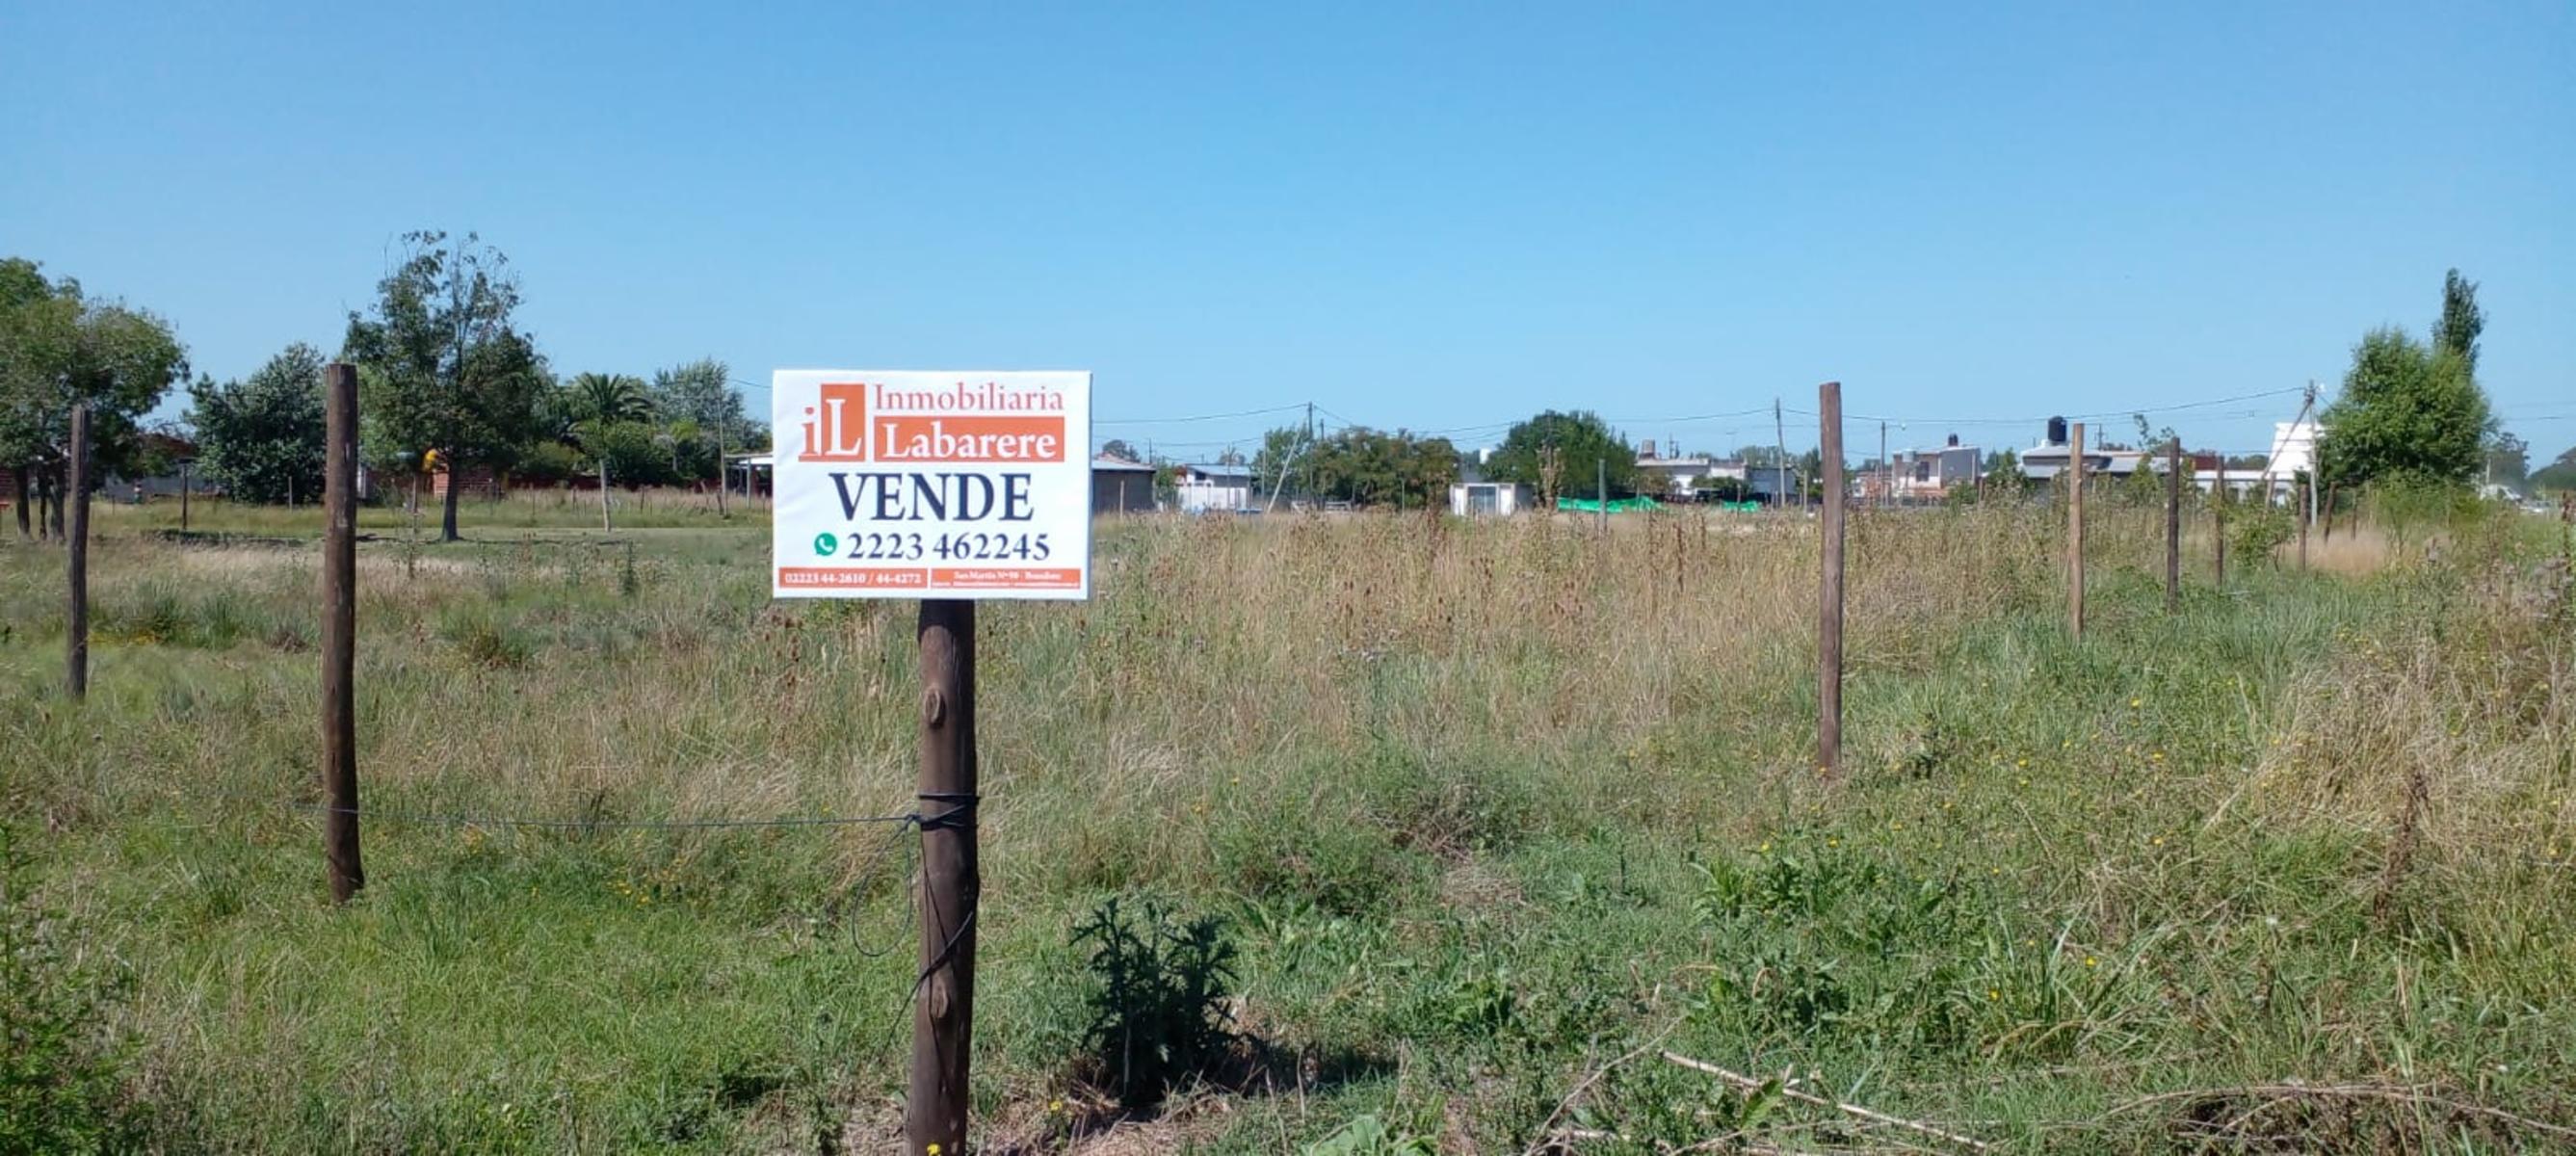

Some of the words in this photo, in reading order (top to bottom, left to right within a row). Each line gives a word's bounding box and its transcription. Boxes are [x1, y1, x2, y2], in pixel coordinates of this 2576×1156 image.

[874, 382, 1064, 410] Inmobiliaria
[881, 421, 1057, 459] Labarere
[828, 472, 1035, 521] VENDE
[847, 532, 924, 561] 2223
[933, 532, 1050, 561] 462245
